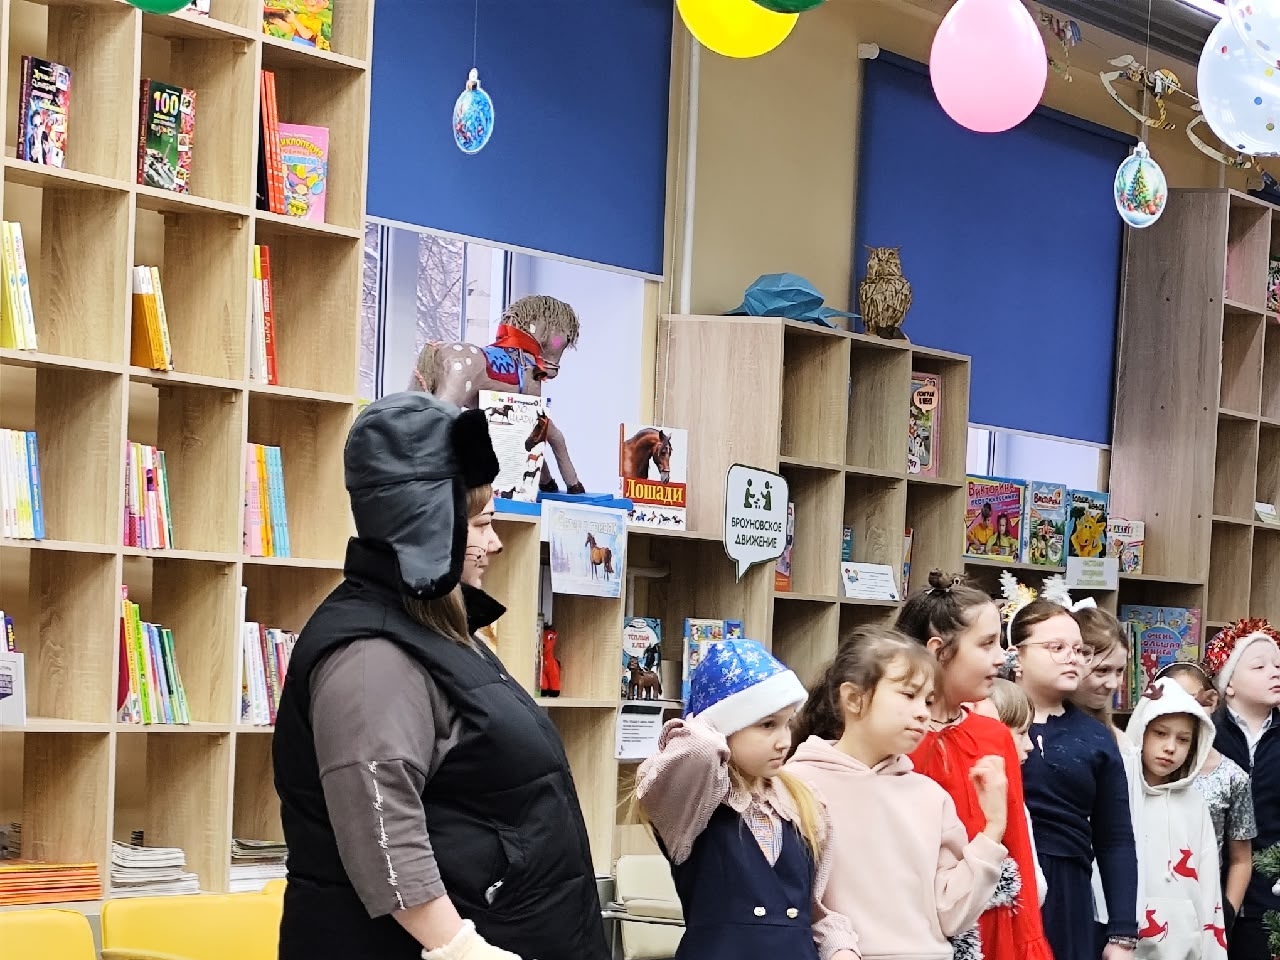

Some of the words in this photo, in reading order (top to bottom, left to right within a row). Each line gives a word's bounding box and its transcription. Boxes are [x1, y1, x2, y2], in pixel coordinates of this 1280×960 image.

[153, 91, 179, 115] 100
[625, 478, 684, 505] Лошади
[731, 517, 782, 532] БРОУНОВСКОЕ
[734, 533, 777, 549] ДВИЖЕНИЕ
[1147, 632, 1174, 640] ОЧЕНЬ
